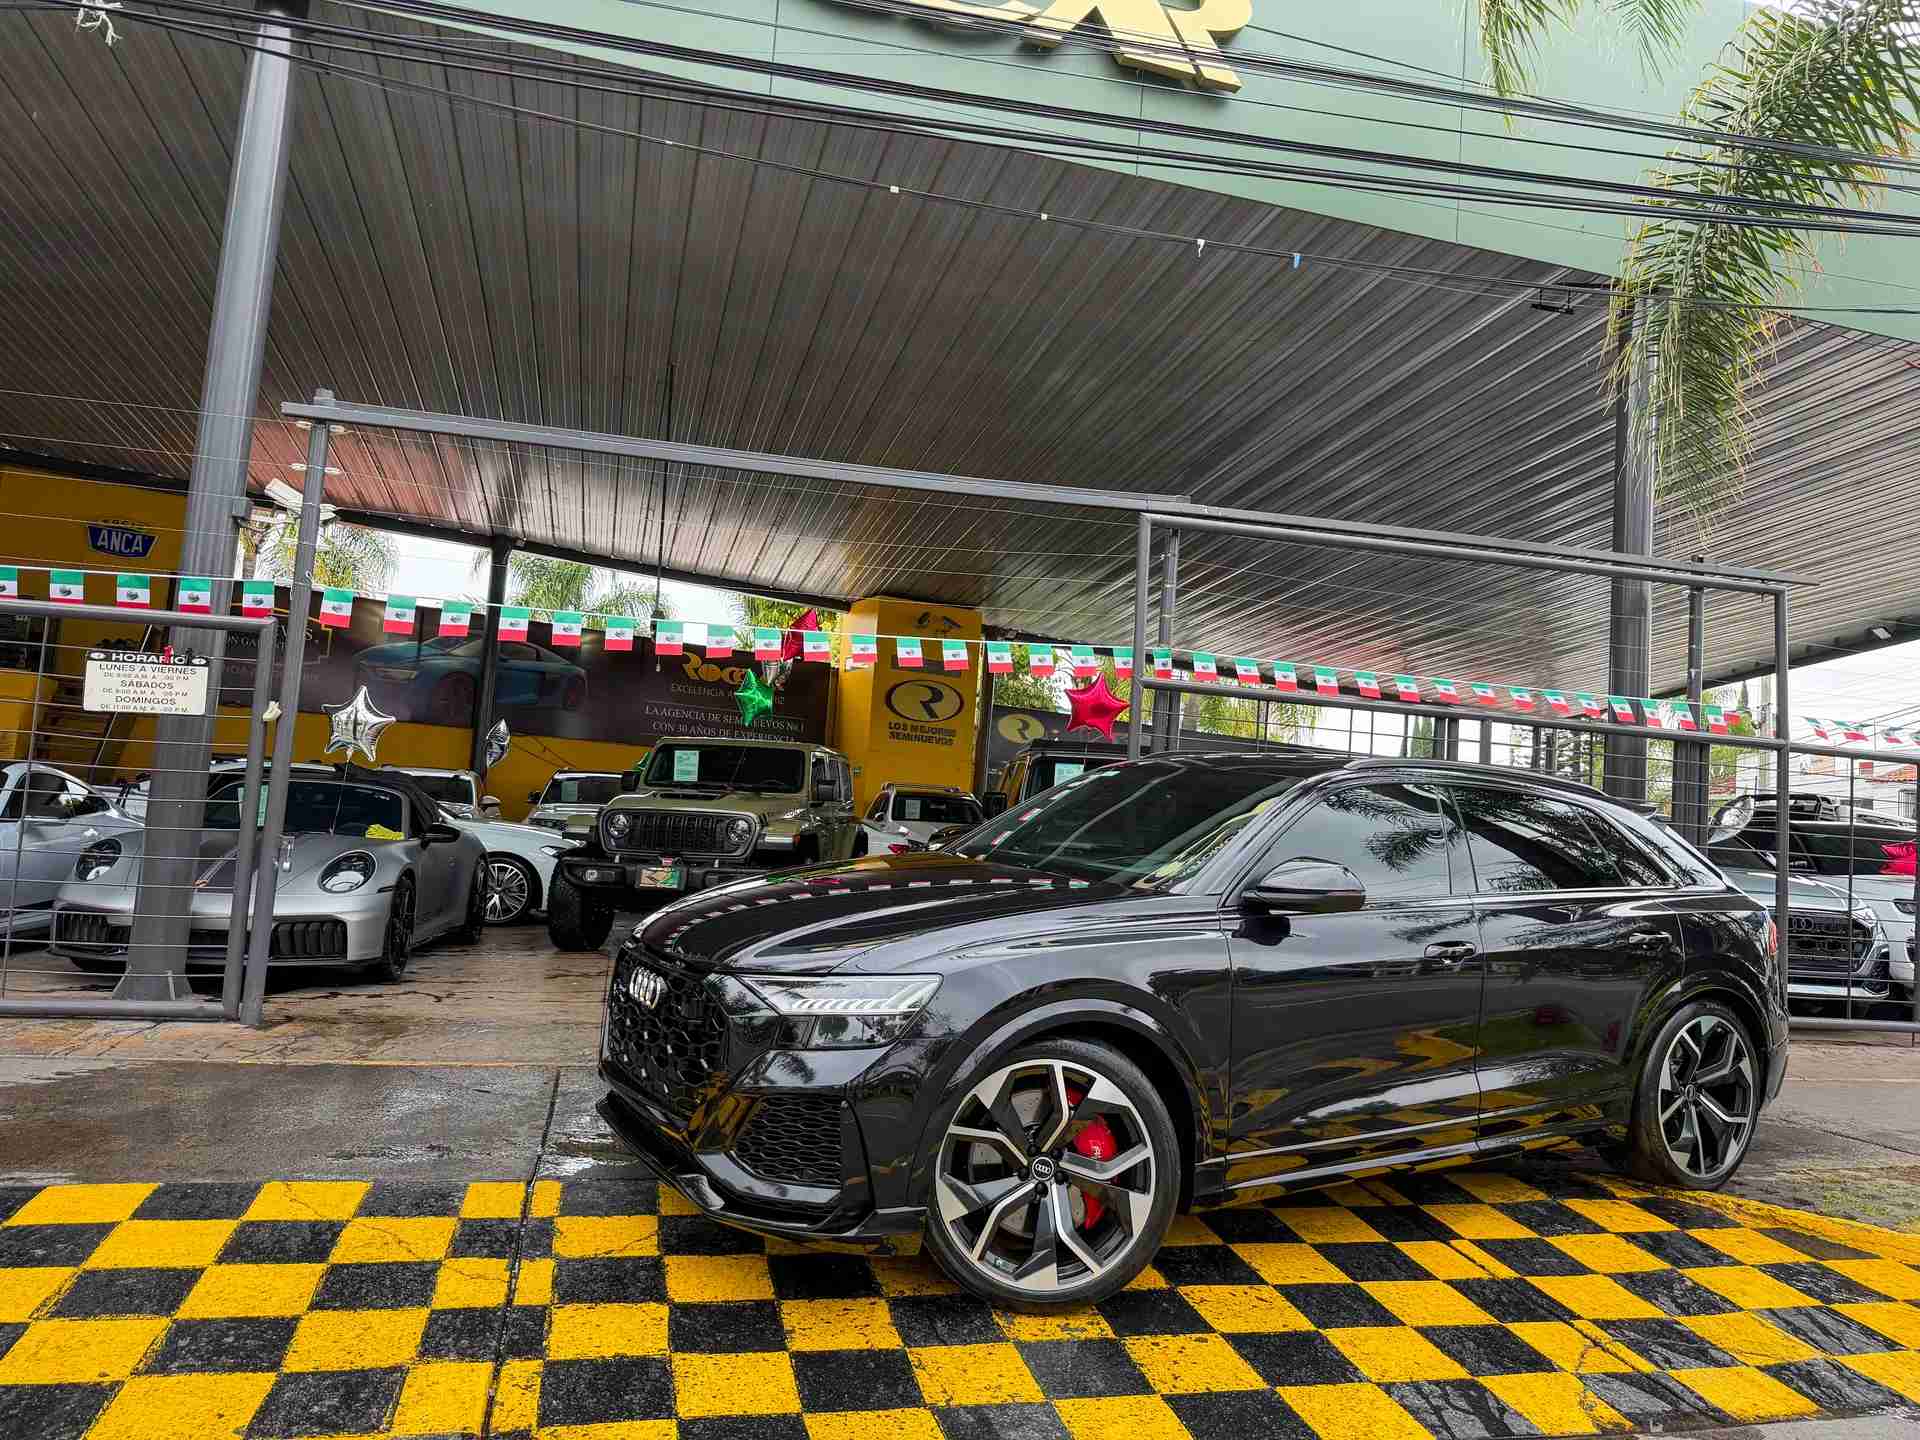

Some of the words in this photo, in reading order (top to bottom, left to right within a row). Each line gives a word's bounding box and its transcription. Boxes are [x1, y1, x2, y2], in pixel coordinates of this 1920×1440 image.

[97, 528, 143, 553] ANCA
[111, 652, 186, 665] HORARIO
[99, 663, 136, 672] LUNES
[138, 664, 147, 673] A
[150, 665, 197, 675] VIERNES
[115, 695, 177, 706] DOMINGOS
[644, 703, 660, 715] LA
[661, 705, 706, 721] AGENCIA
[723, 712, 785, 730] SEMUEVOS
[652, 720, 675, 733] CON
[719, 728, 732, 738] DE
[888, 721, 908, 733] LOS
[910, 723, 957, 736] MEJORES
[888, 731, 955, 746] SEMINUEVOS
